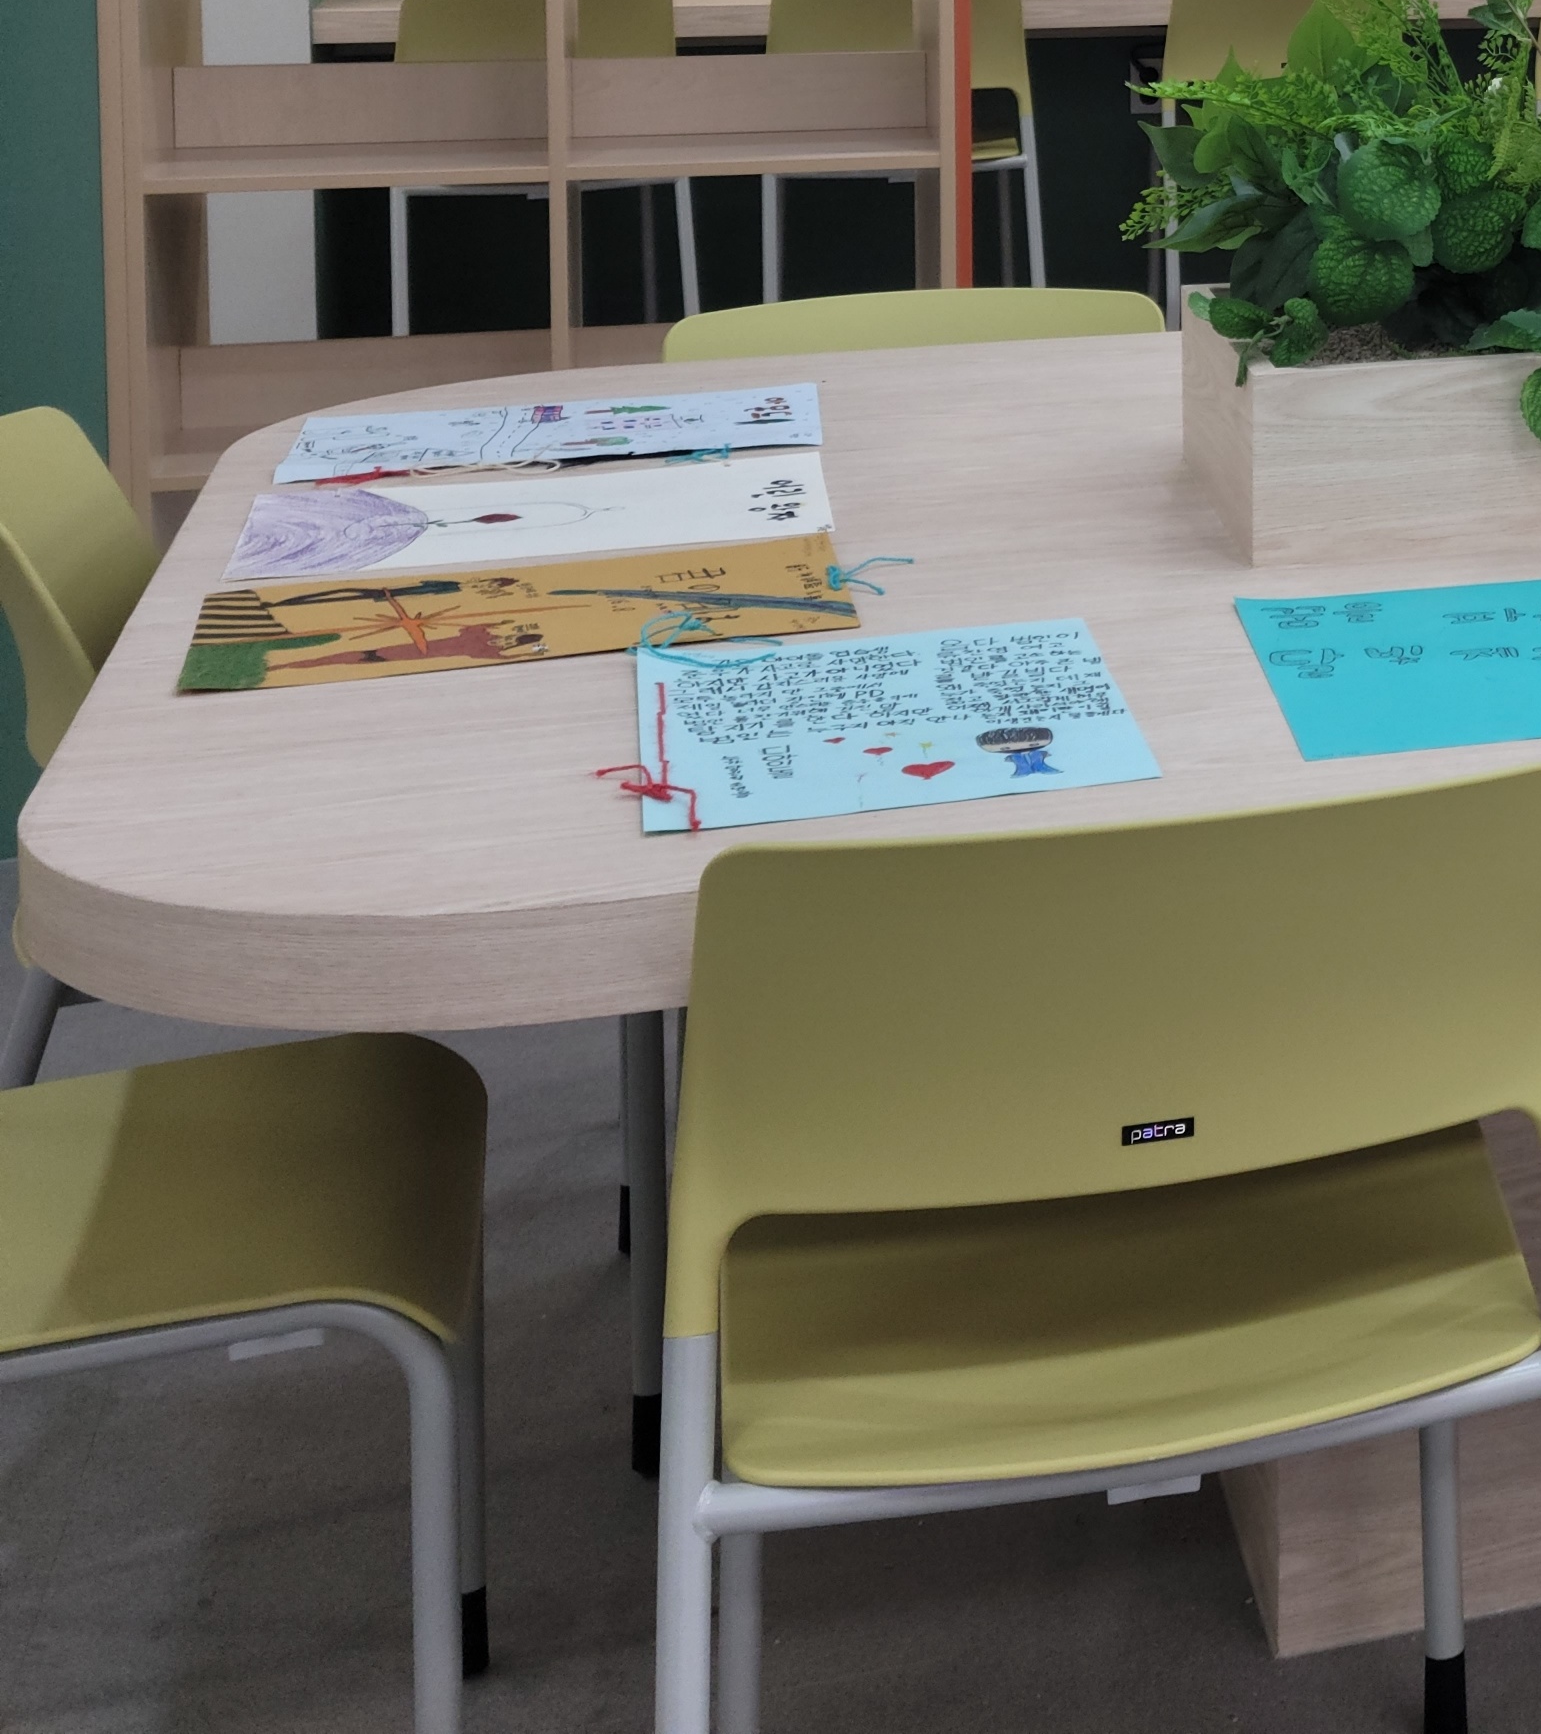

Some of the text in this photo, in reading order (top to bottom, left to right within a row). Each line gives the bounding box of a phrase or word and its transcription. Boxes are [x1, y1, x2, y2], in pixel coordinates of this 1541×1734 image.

[751, 479, 807, 498] 어린
[748, 502, 801, 521] 왕자
[1261, 602, 1383, 630] 꿈을
[1130, 1123, 1186, 1145] patra
